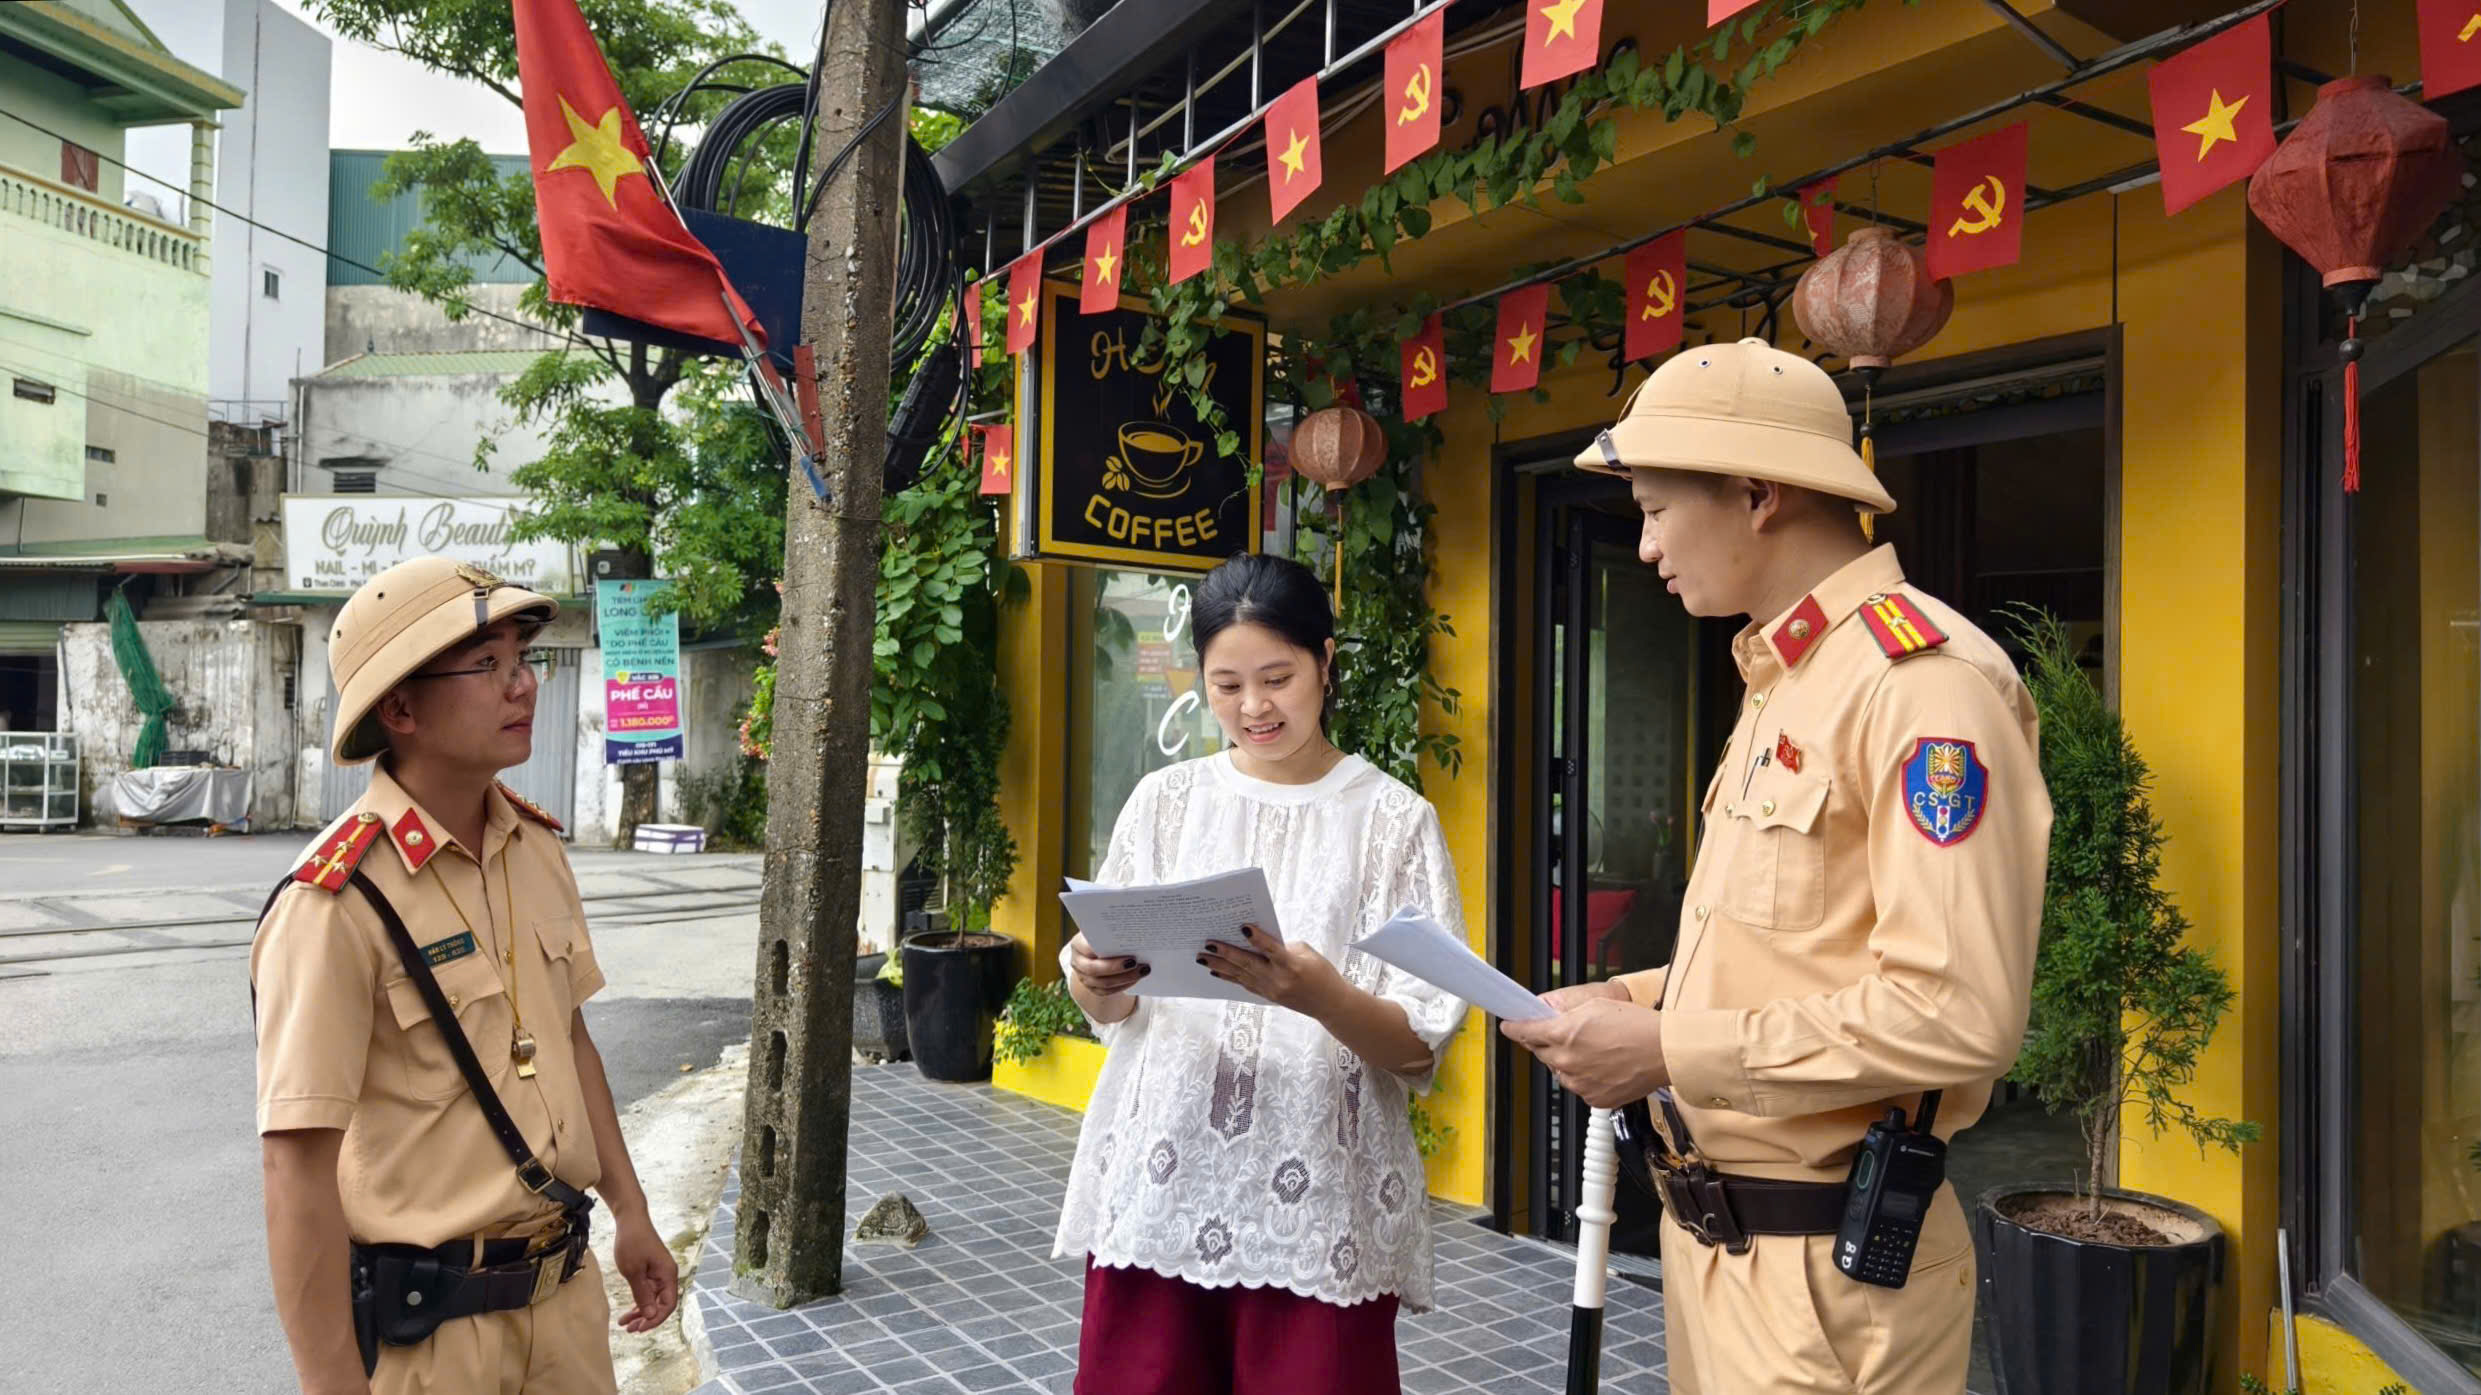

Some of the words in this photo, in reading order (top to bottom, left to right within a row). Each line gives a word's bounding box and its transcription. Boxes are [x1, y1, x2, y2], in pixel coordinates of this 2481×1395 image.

[1085, 494, 1218, 548] COFFEE
[322, 504, 409, 556] Quỳnh
[314, 560, 346, 575] NAIL
[604, 606, 637, 617] LONG
[610, 685, 641, 702] PHẾ
